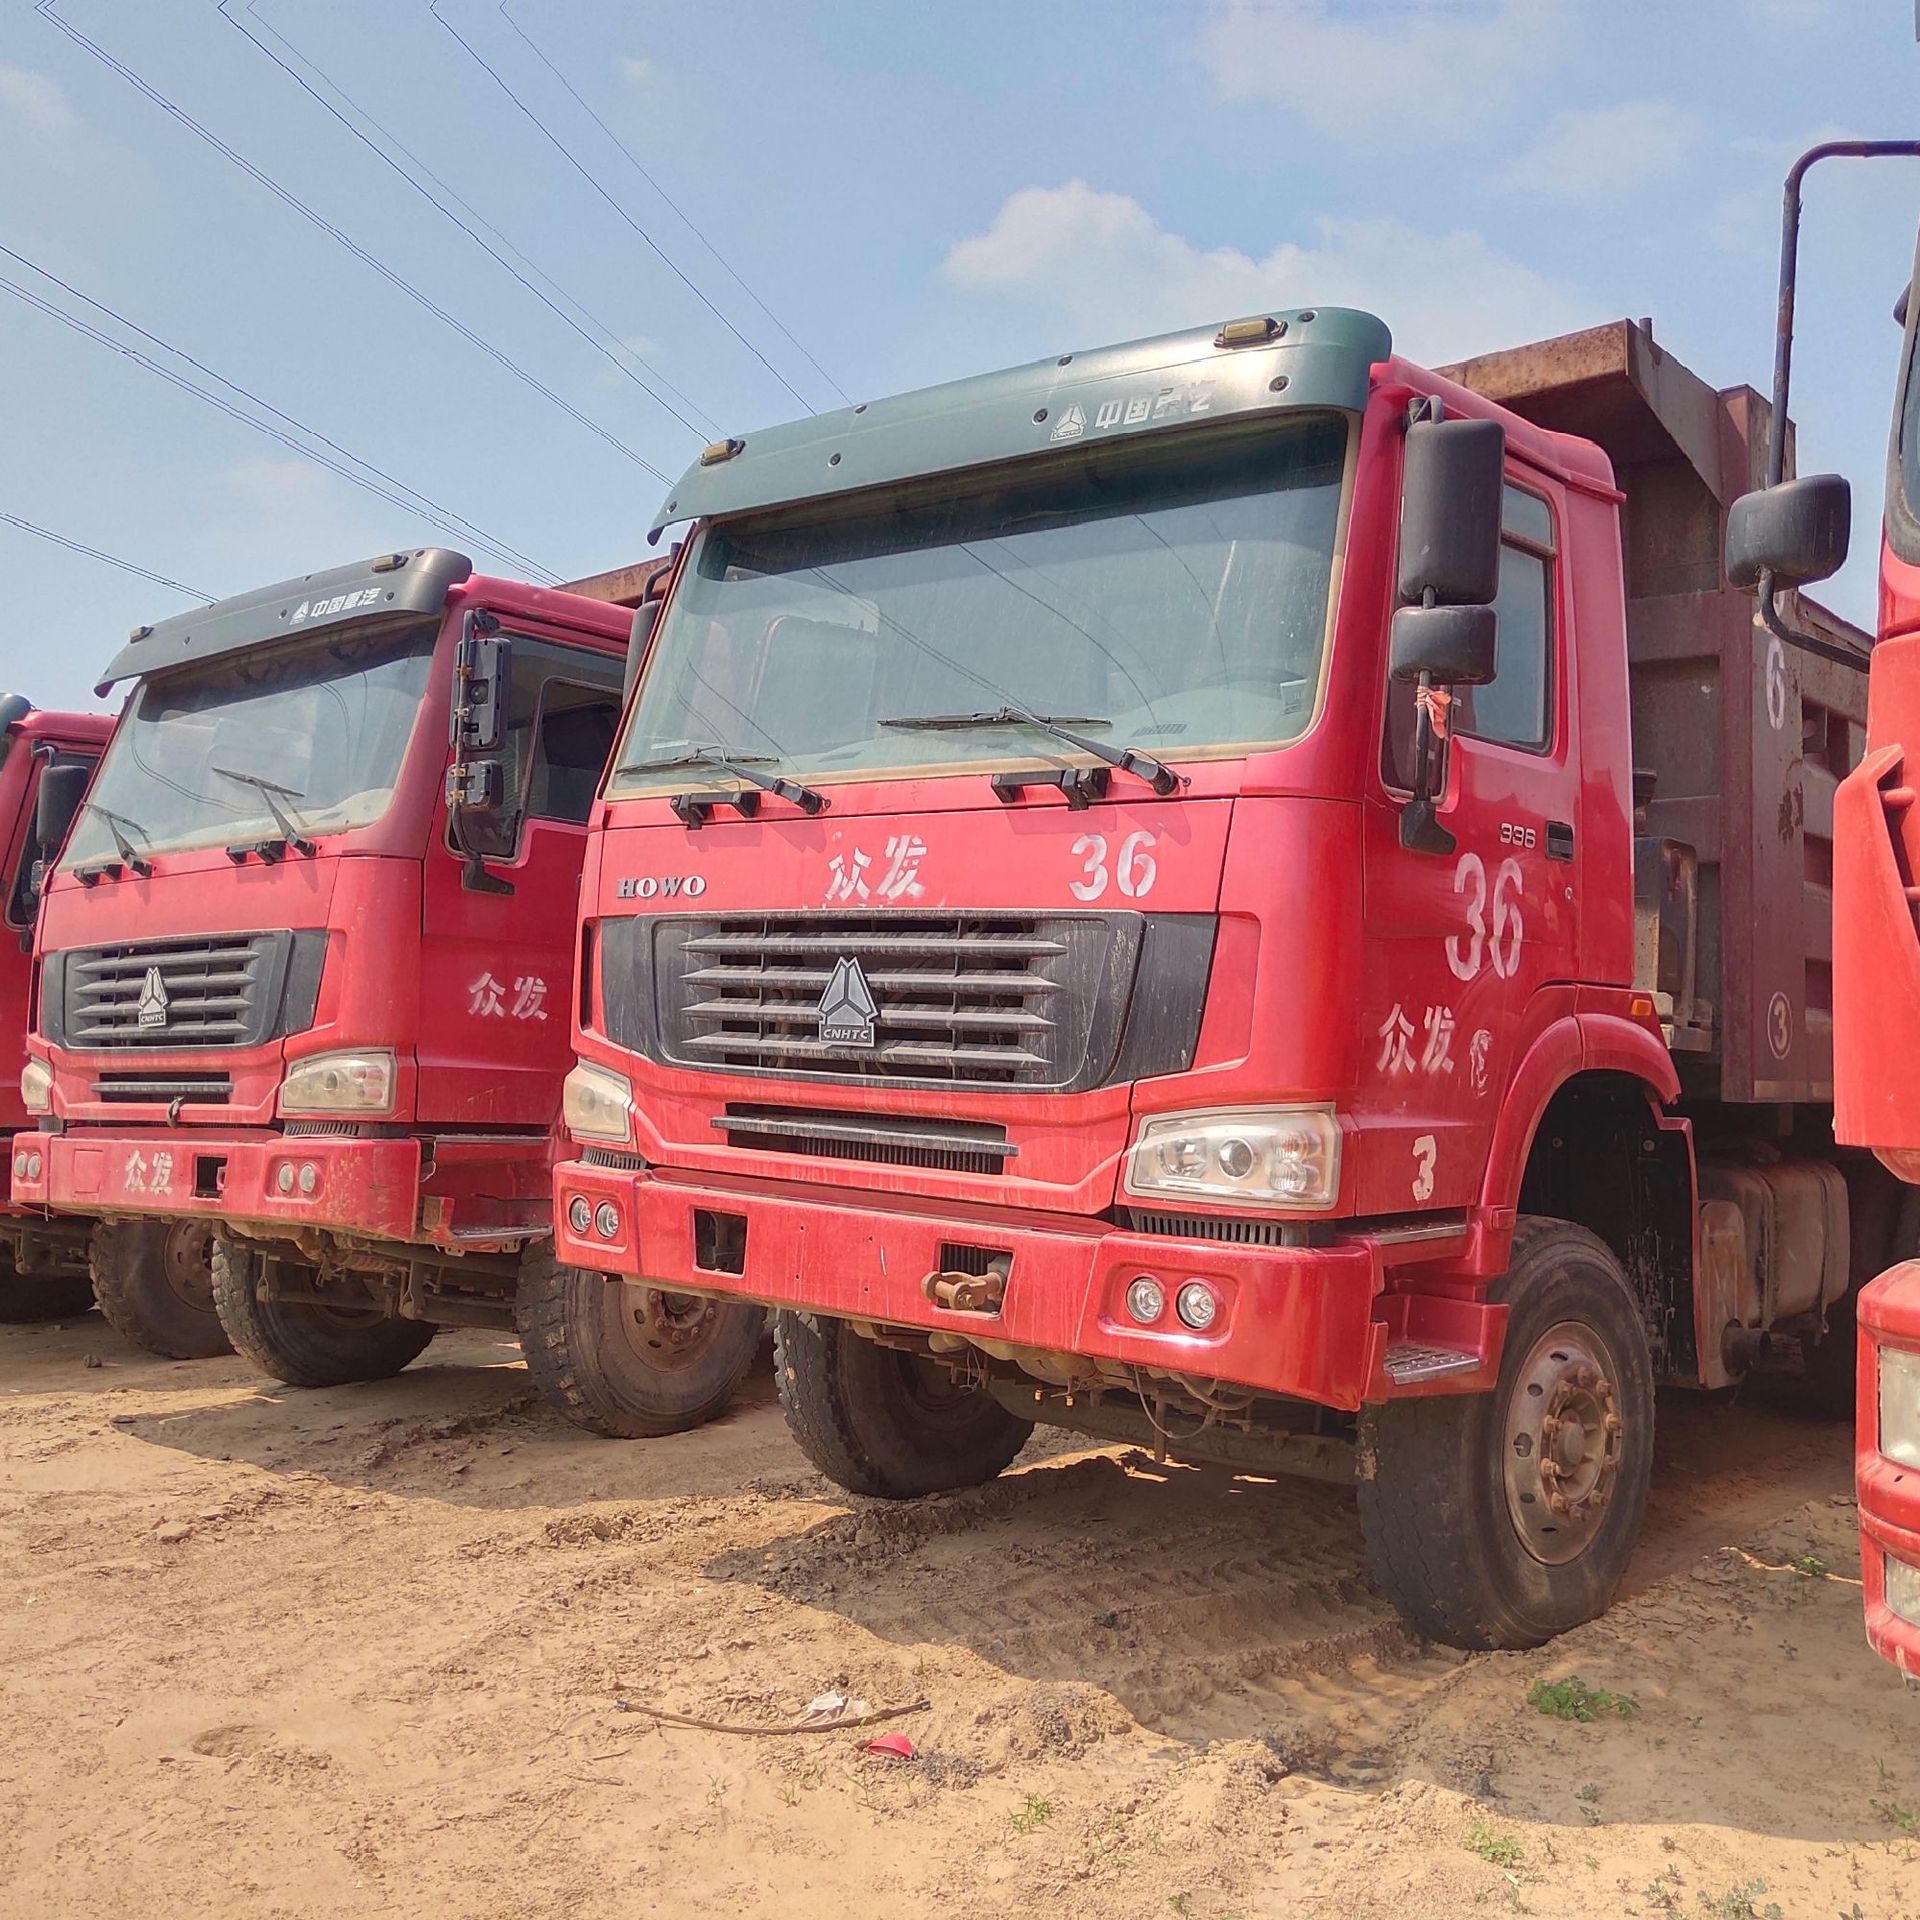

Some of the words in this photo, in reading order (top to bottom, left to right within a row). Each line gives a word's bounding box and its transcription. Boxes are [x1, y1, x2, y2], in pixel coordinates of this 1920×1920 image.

[1095, 380, 1217, 429] 中国
[310, 587, 382, 618] 中国重汽
[1500, 822, 1536, 849] 336
[616, 875, 707, 898] HOWO
[1069, 831, 1157, 902] 36
[1445, 852, 1523, 982] 36
[141, 1014, 163, 1023] CNHTC
[467, 971, 549, 1021] 众发
[823, 1028, 869, 1040] CNHTC
[1375, 1002, 1456, 1076] 众发
[1412, 1134, 1437, 1202] 3
